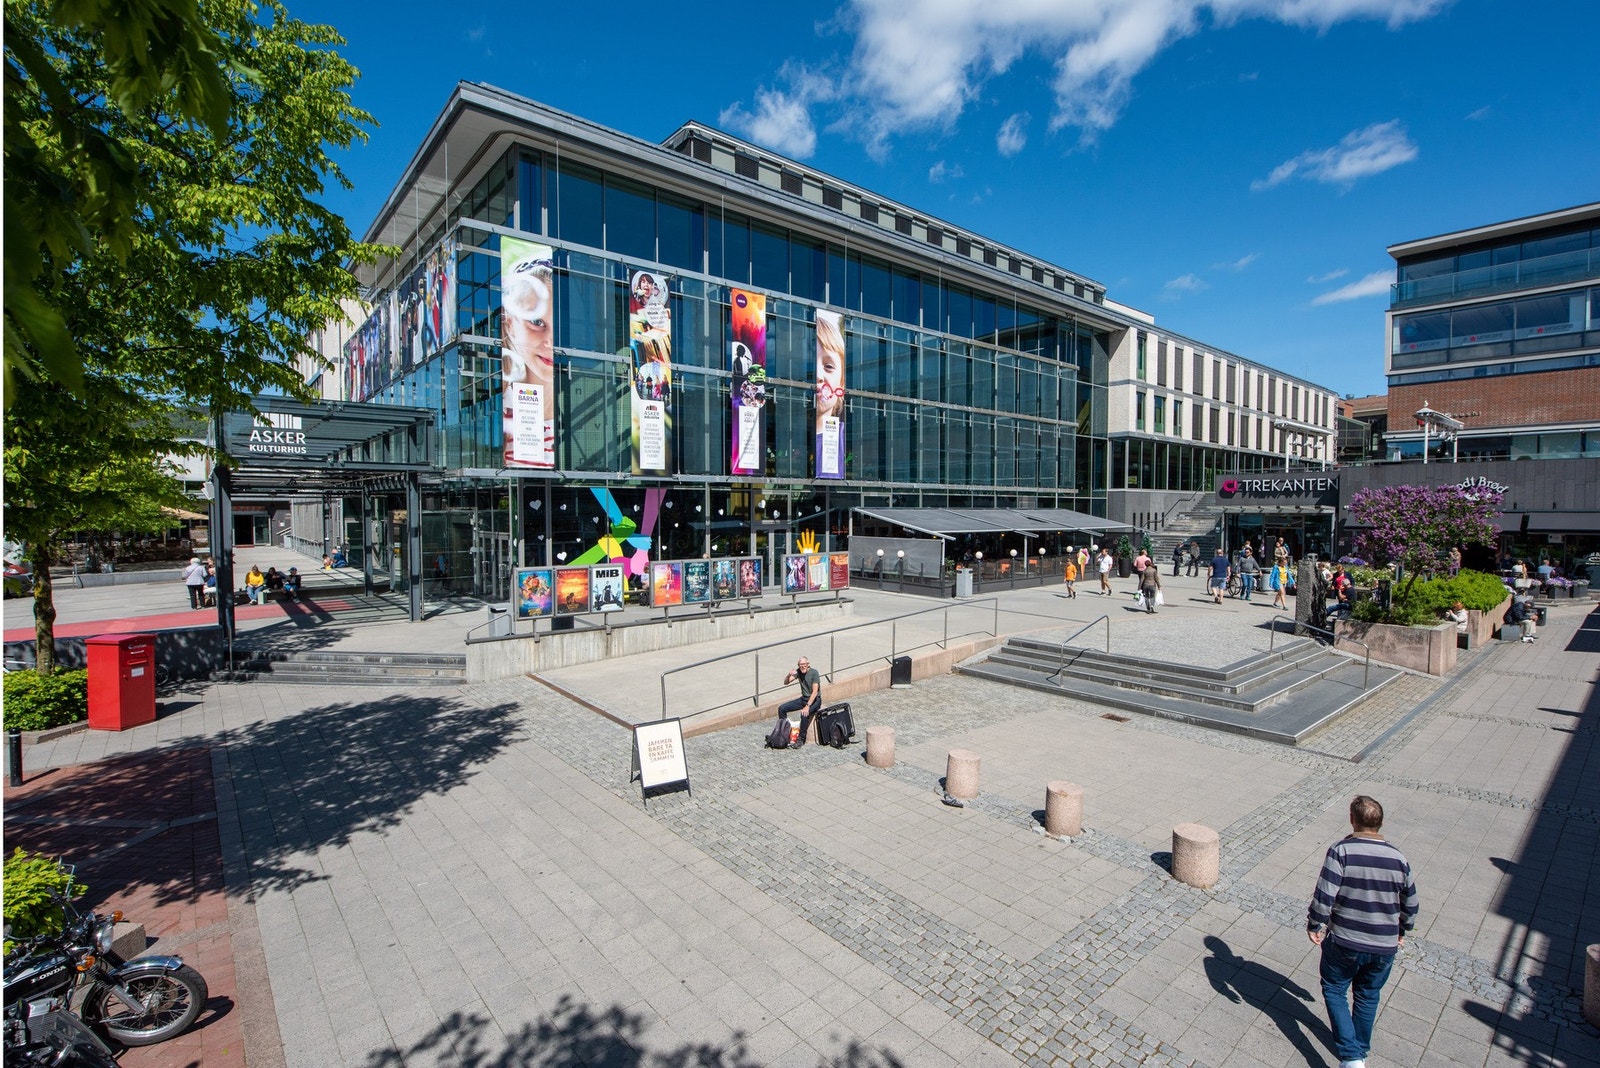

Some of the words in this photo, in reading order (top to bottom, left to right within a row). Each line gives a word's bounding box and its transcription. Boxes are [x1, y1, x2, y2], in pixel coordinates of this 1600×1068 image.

[249, 429, 306, 445] ASKER
[249, 444, 307, 454] KULTURHUS
[1242, 477, 1339, 492] TREKANTEN
[1478, 476, 1510, 494] Brød
[648, 744, 664, 752] BARE
